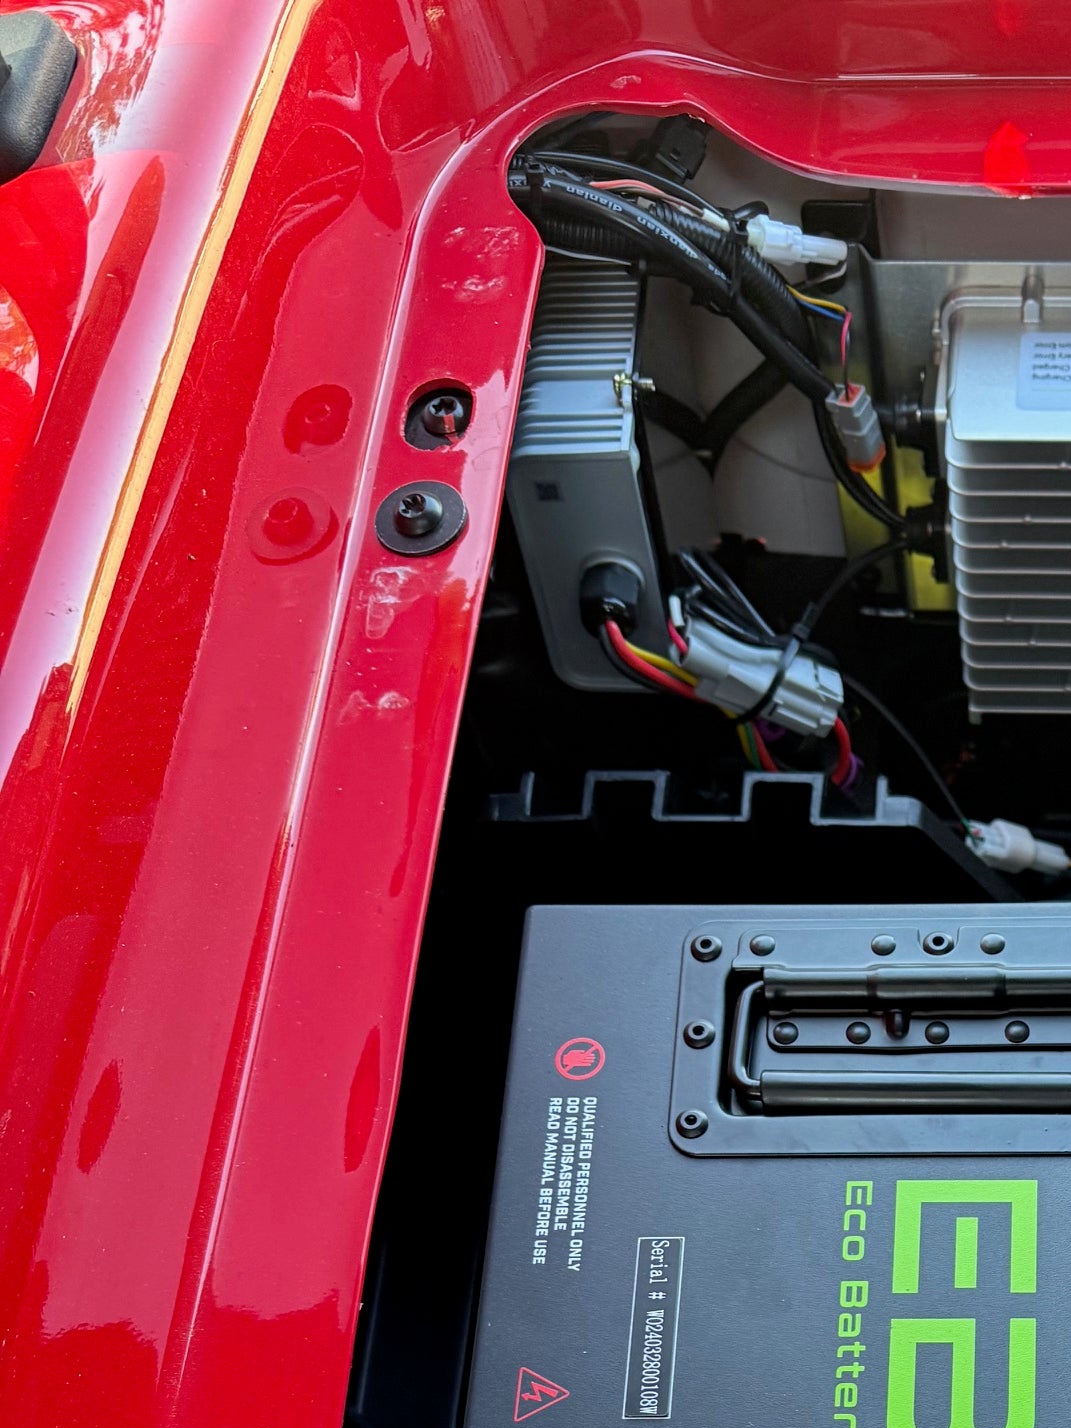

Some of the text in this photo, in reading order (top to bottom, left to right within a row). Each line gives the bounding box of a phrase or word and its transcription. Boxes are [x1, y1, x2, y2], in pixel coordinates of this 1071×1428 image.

[532, 1097, 562, 1265] READ MANUAL BEFORE USE
[553, 1097, 580, 1231] DO NOT DISASSEMBLE
[567, 1097, 597, 1271] QUALIFIED PERSONNEL ONLY
[842, 1180, 873, 1261] Eco
[649, 1240, 670, 1284] Serial
